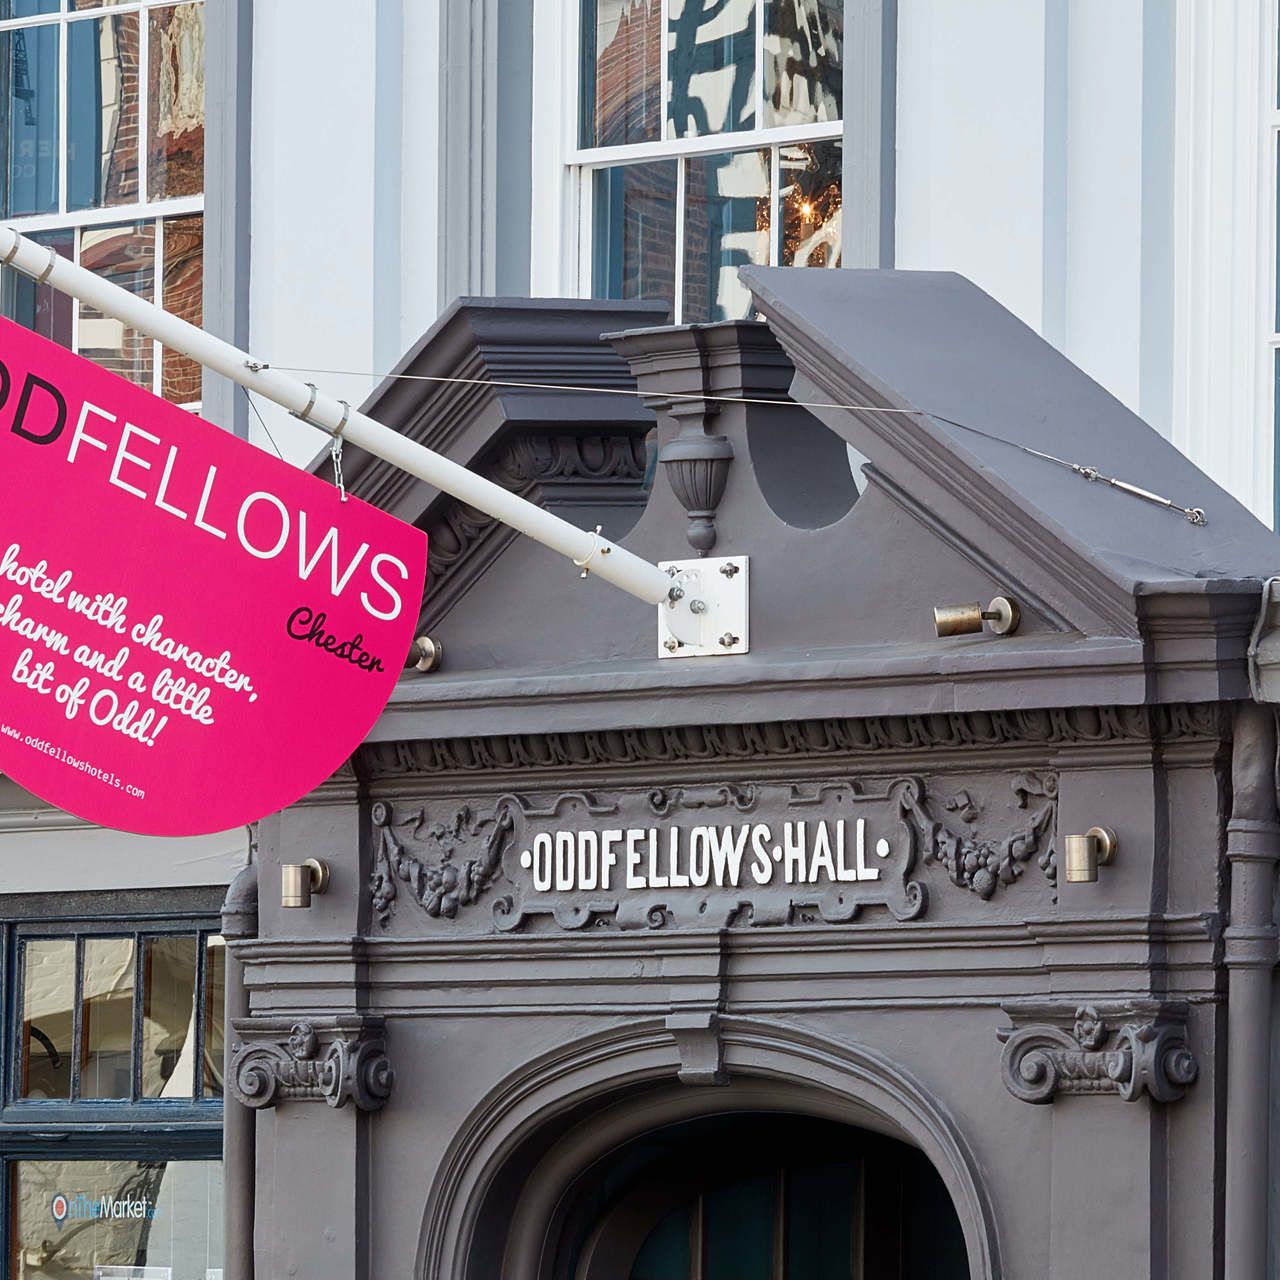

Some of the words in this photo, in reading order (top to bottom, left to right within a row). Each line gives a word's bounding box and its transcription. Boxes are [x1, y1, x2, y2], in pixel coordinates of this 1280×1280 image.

[0, 543, 72, 603] hotel
[67, 590, 128, 634] with
[131, 614, 258, 703] character,
[285, 605, 385, 676] Chester
[11, 648, 55, 694] bit
[55, 677, 90, 720] of
[89, 689, 168, 747] Odd!
[73, 646, 130, 681] and
[127, 671, 147, 693] a
[152, 668, 215, 725] little
[0, 723, 145, 800] www.oddfellowshotels.com
[532, 824, 773, 892] ODDFELLOWS
[783, 818, 879, 884] HALL
